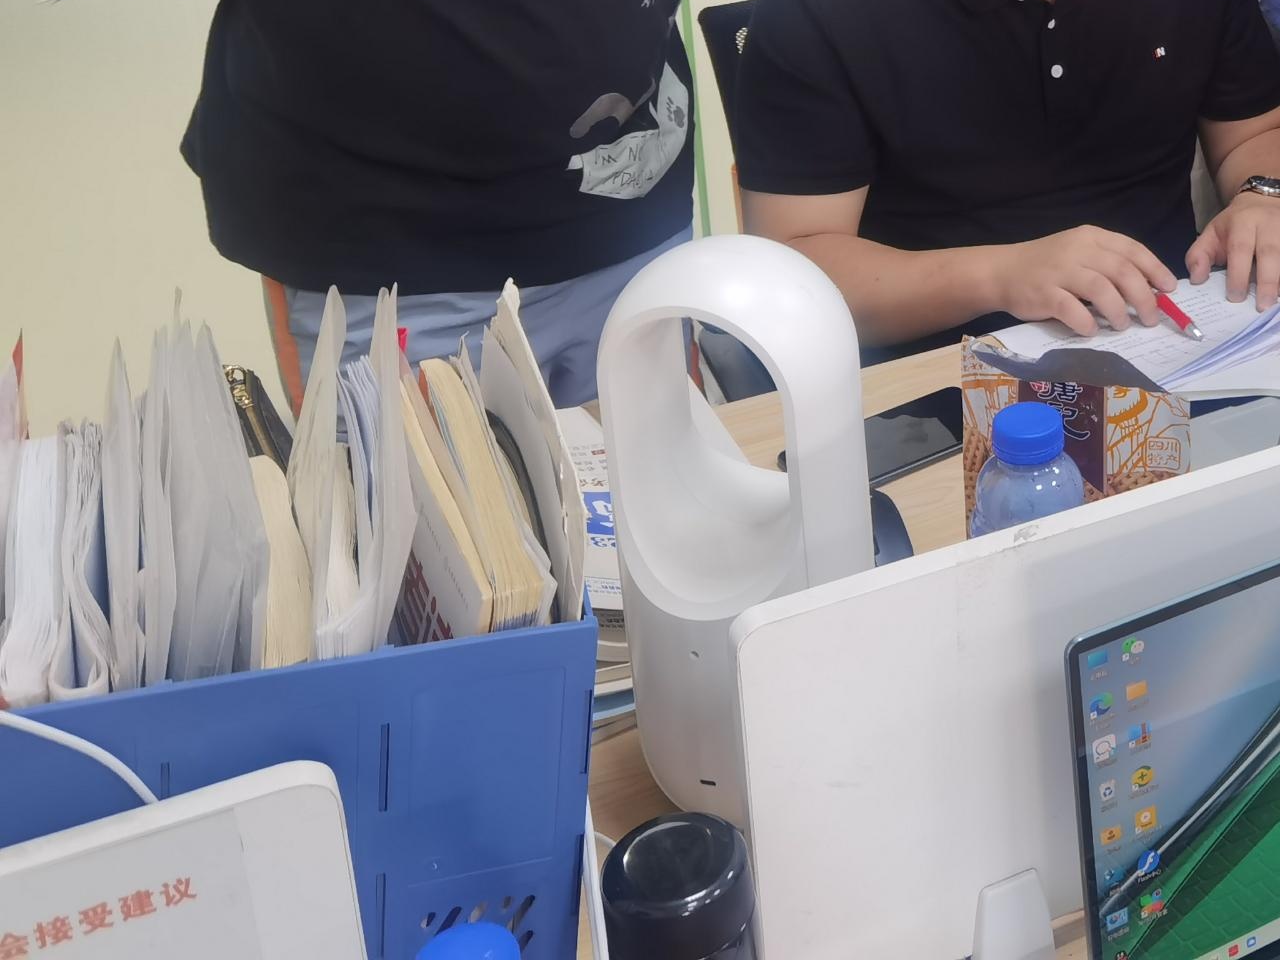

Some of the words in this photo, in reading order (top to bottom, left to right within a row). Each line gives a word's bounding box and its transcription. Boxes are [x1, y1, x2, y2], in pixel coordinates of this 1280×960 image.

[1148, 440, 1177, 454] 四川
[0, 876, 197, 960] 会接受建议
